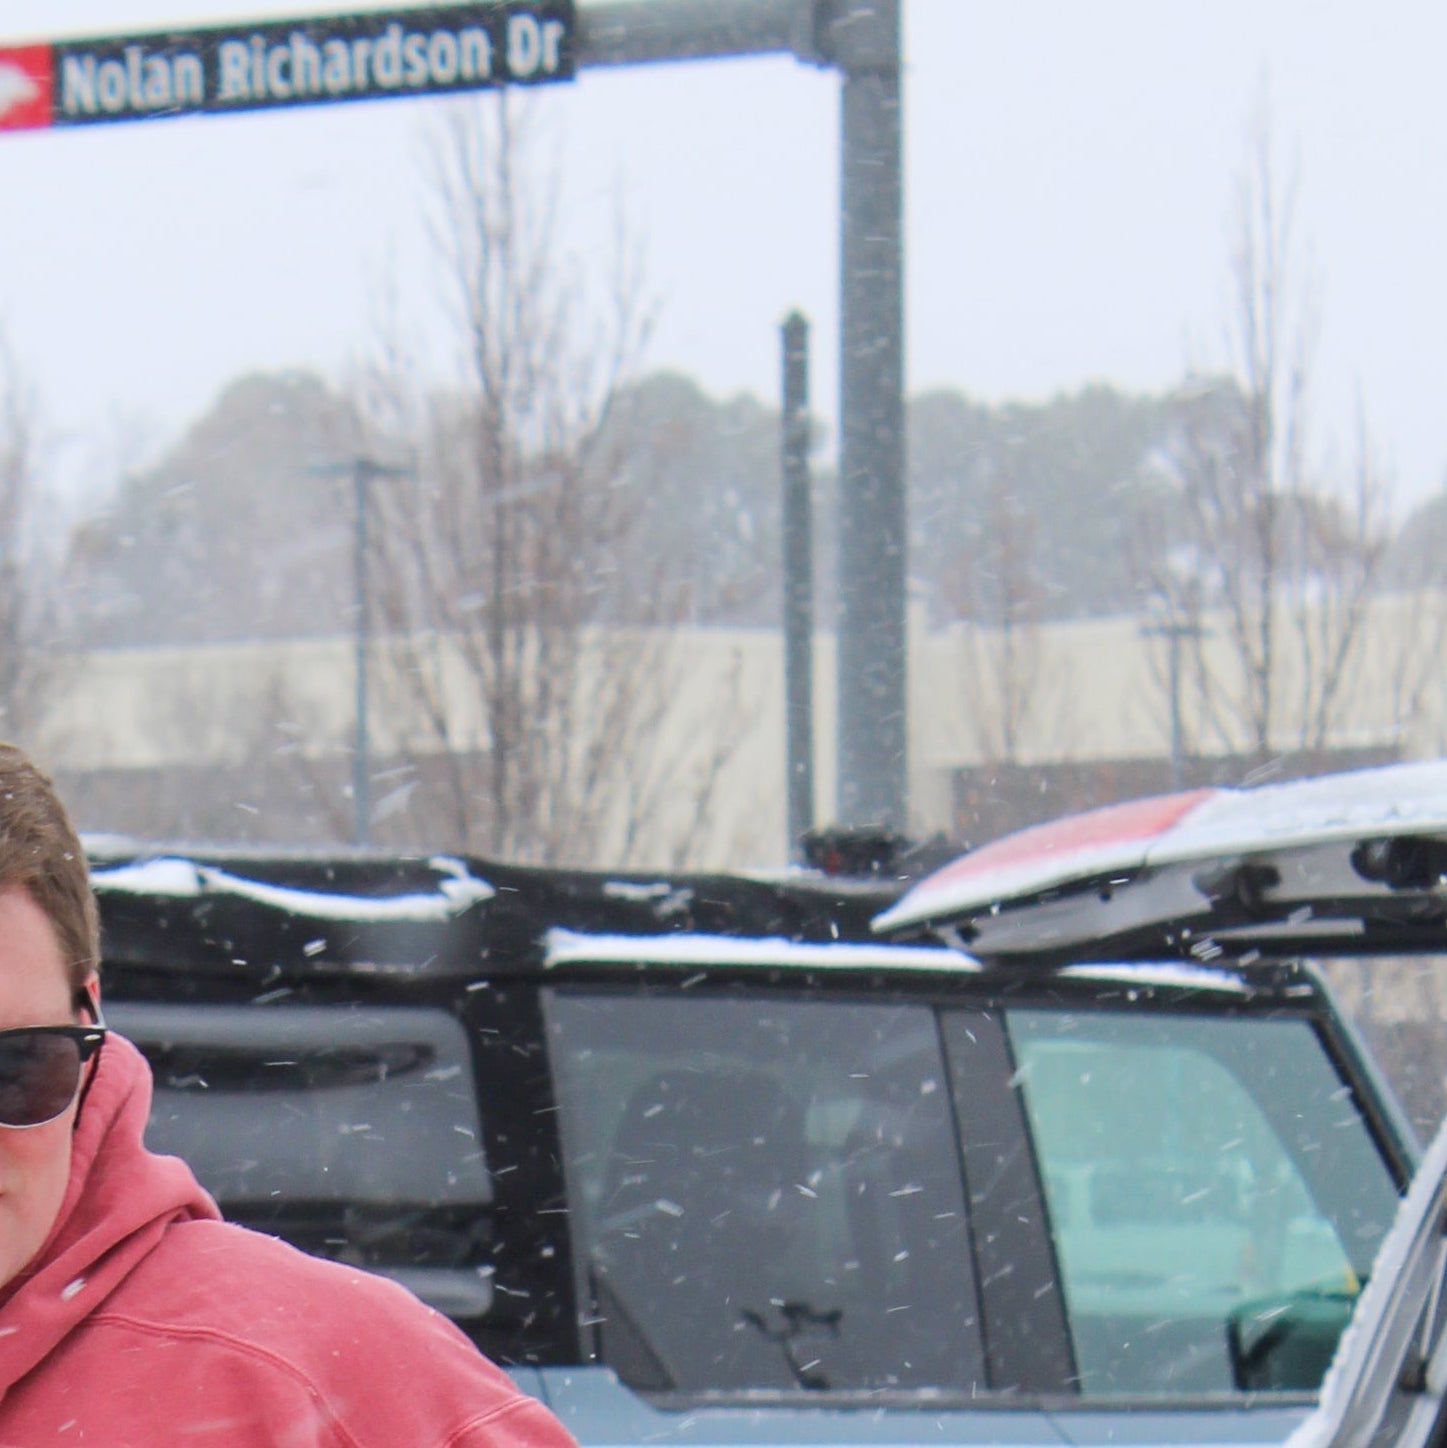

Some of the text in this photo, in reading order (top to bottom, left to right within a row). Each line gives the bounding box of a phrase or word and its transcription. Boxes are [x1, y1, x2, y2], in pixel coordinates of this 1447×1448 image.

[62, 12, 564, 117] Nolan Richardson Dr
